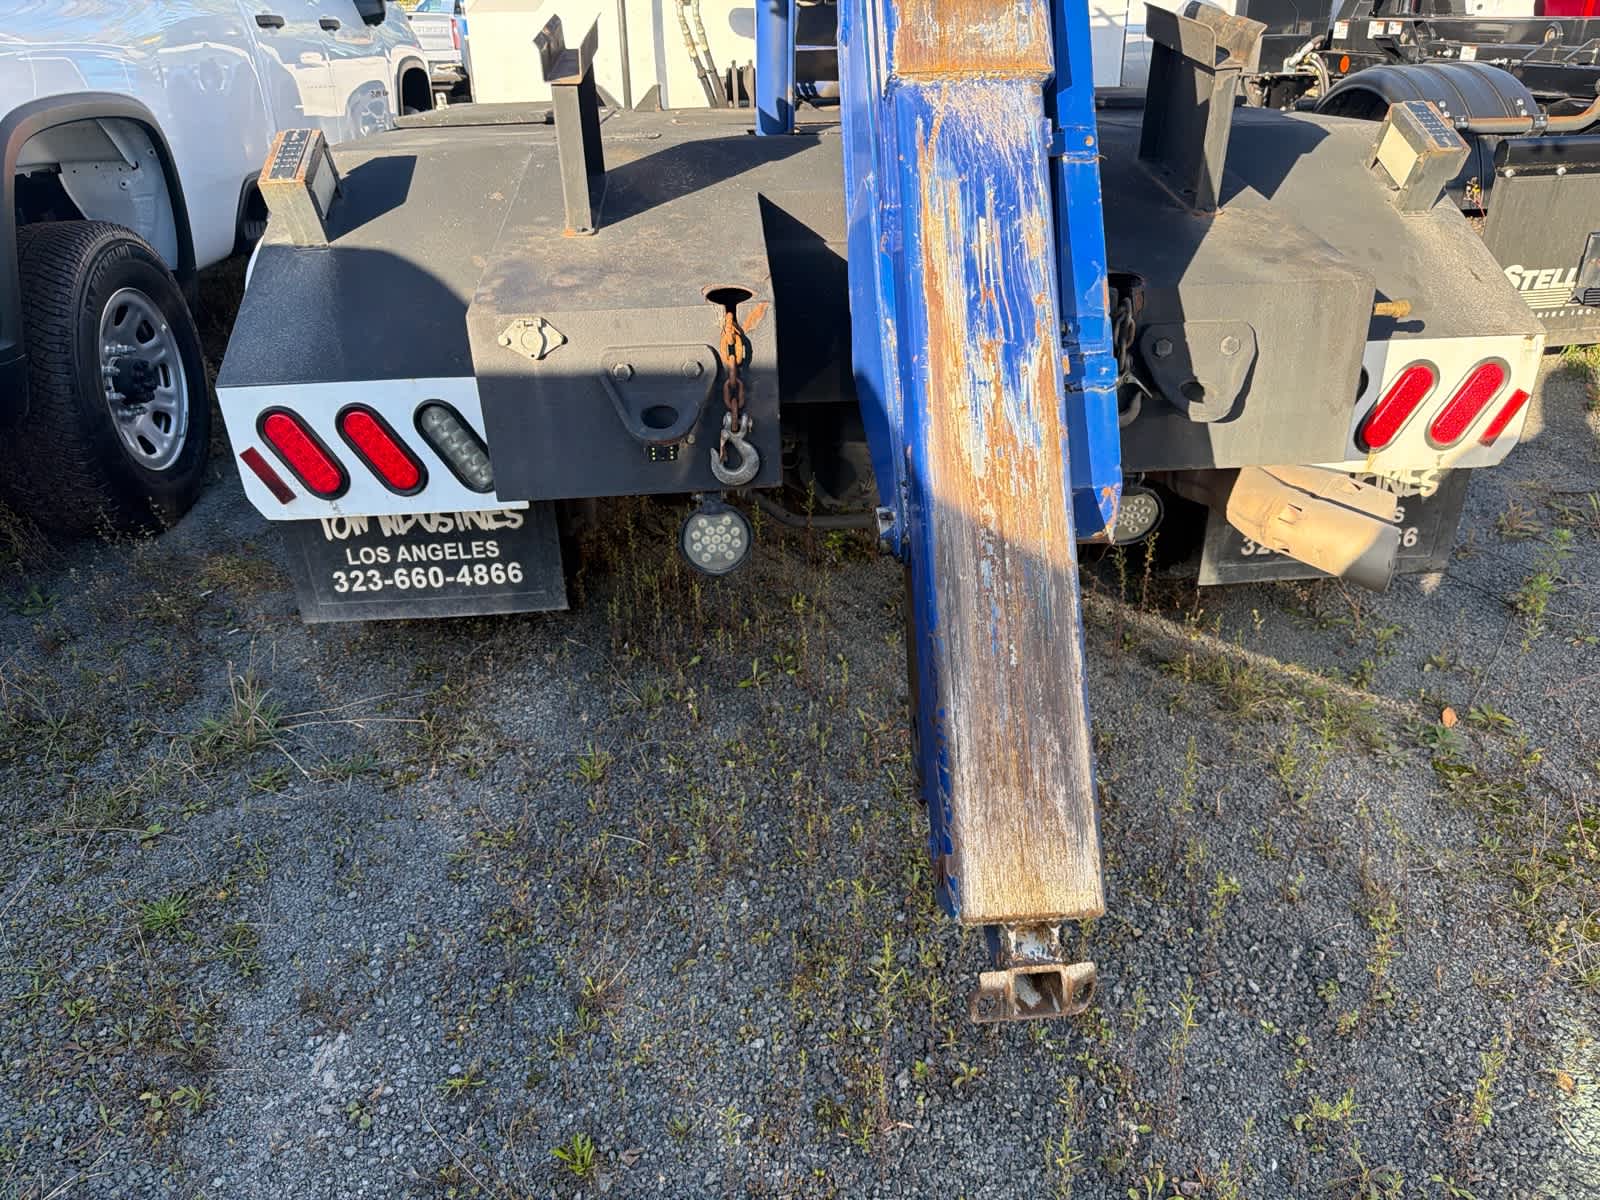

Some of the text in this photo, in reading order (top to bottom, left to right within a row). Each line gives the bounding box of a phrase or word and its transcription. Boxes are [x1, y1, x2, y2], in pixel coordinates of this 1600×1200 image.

[345, 540, 500, 565] LOS ANGELES
[332, 561, 523, 593] 323-660-4866
